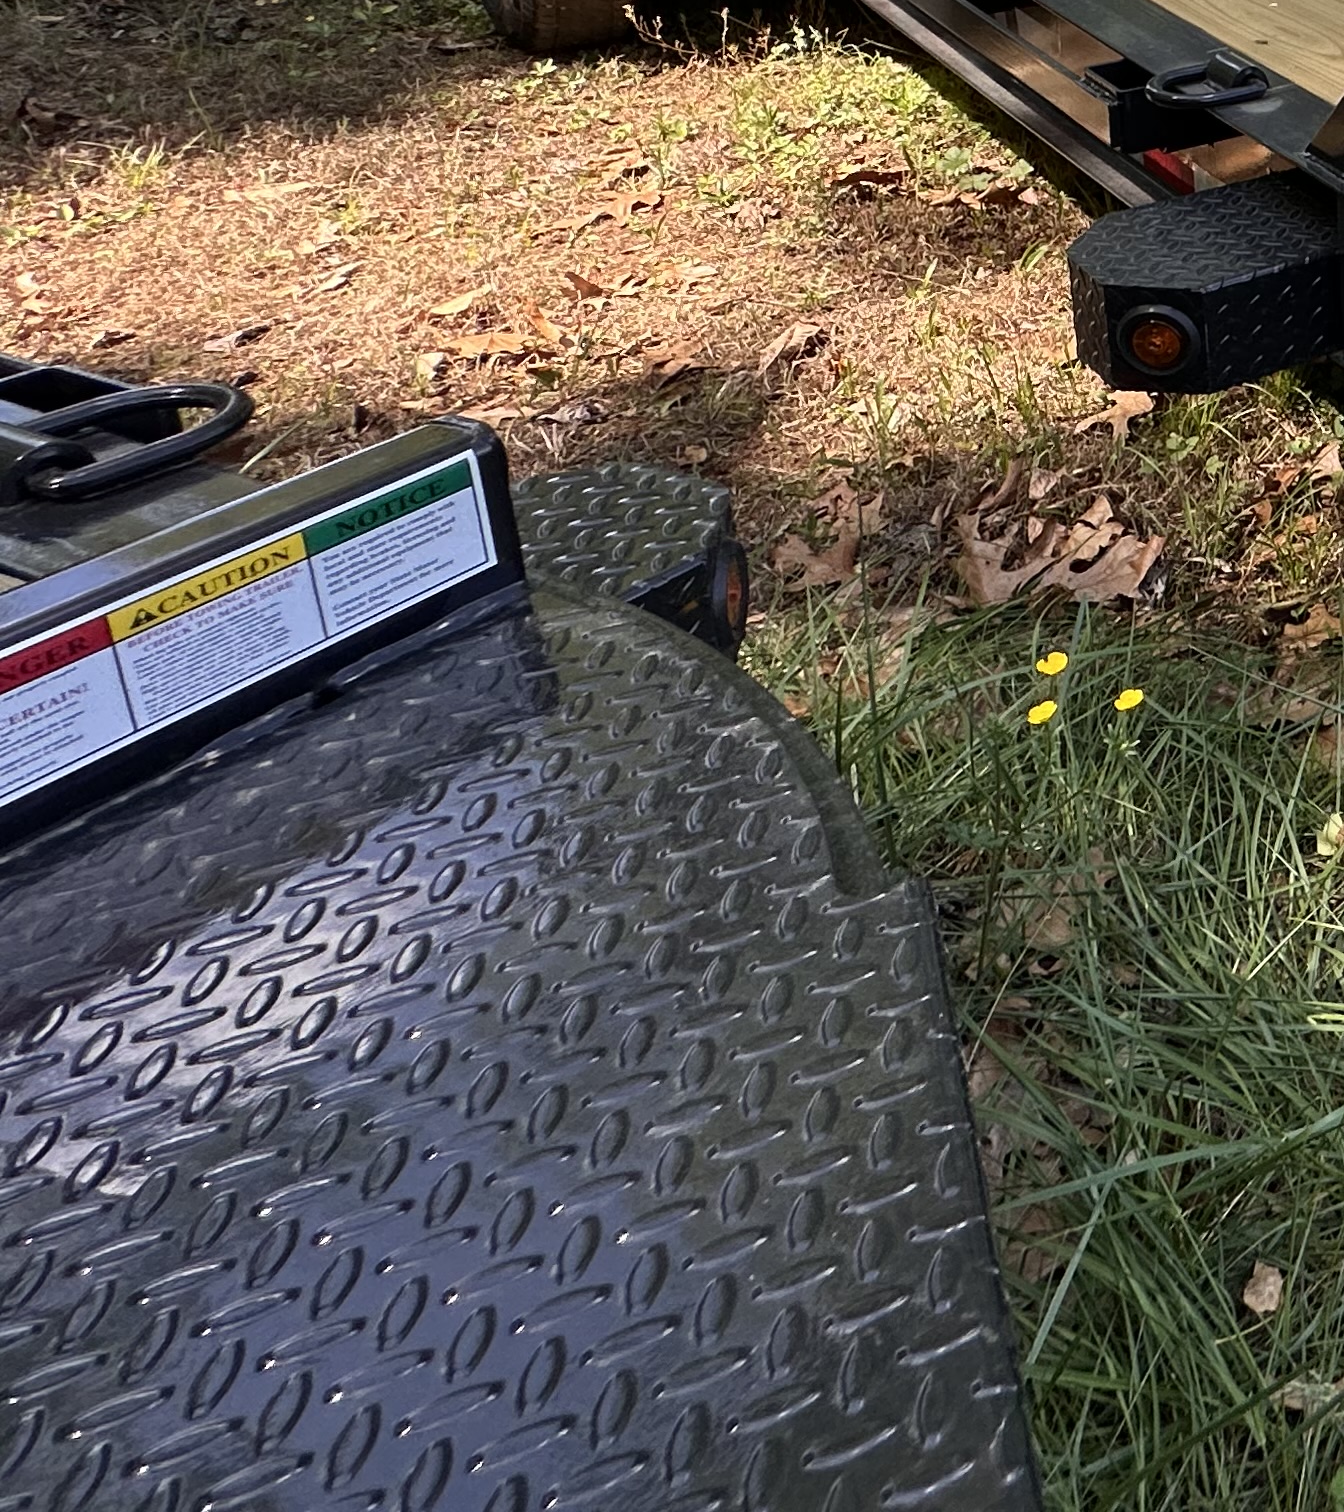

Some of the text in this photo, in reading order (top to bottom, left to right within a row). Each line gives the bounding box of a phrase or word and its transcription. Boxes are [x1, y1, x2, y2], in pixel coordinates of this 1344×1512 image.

[336, 478, 445, 537] NOTICE
[156, 544, 292, 617] CAUTION
[126, 619, 182, 648] BEFORE
[186, 593, 241, 621] TOWING
[142, 627, 191, 652] CHECK
[195, 616, 214, 627] TO
[259, 580, 293, 599] SURE
